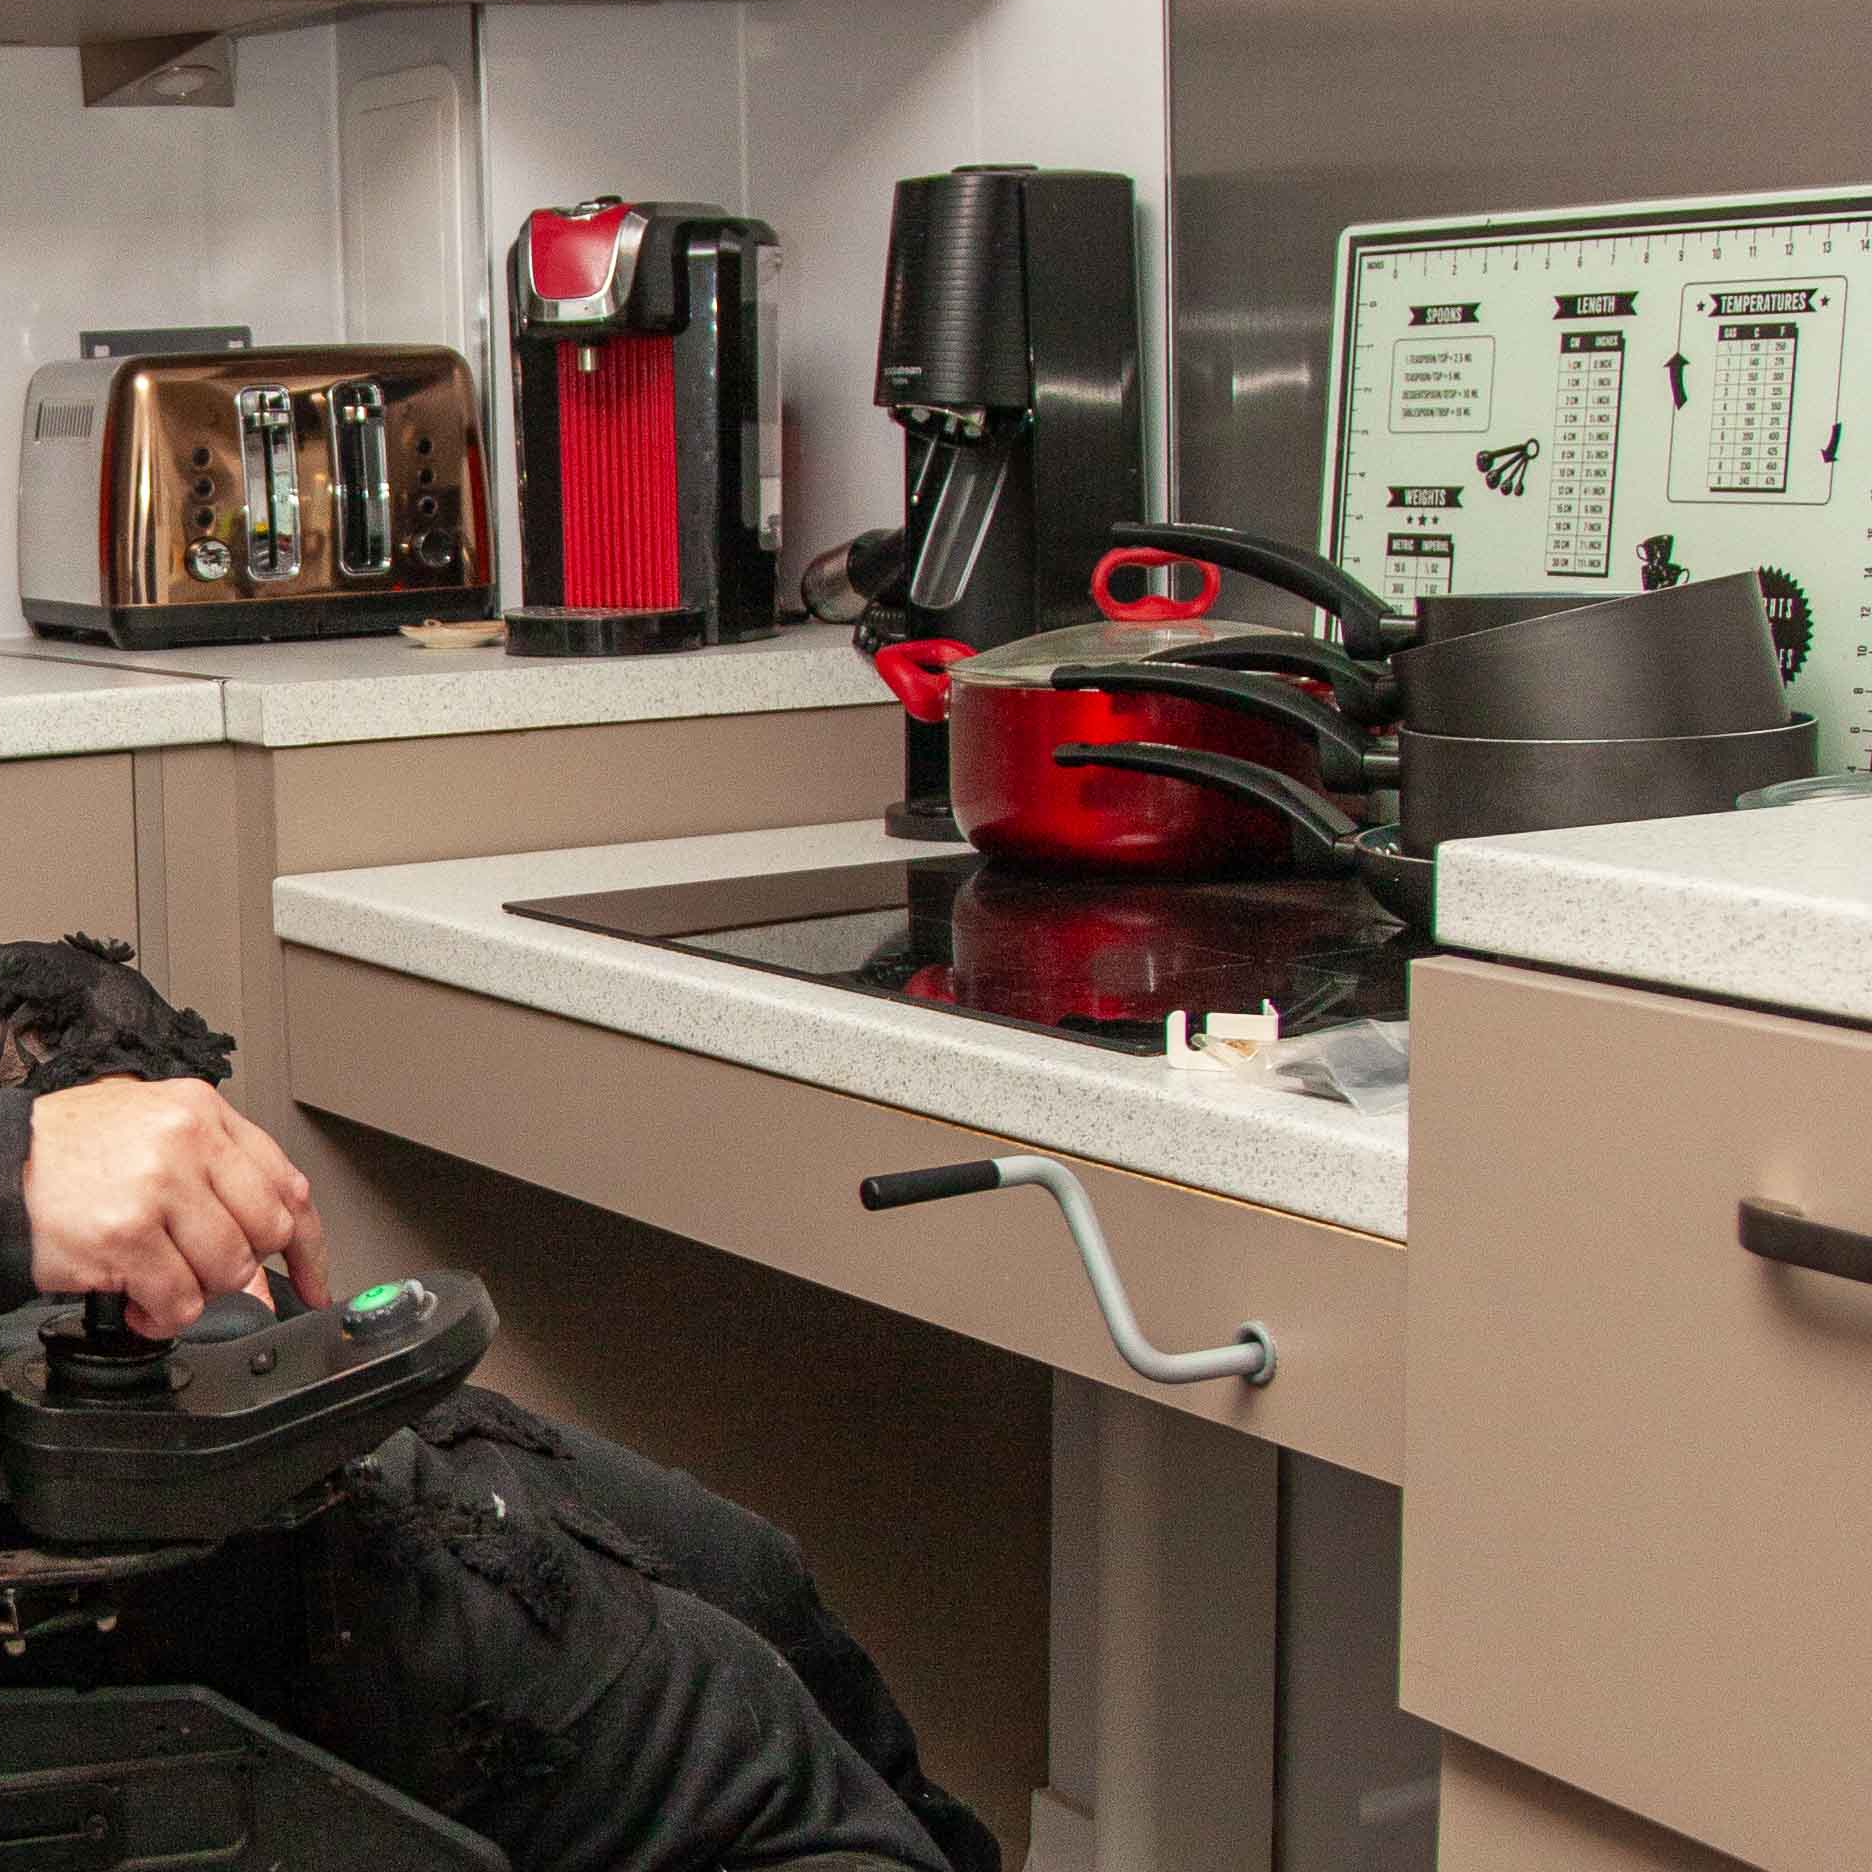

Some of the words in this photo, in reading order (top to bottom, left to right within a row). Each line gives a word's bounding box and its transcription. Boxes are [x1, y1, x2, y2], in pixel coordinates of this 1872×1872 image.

[1748, 245, 1757, 257] 11
[1785, 242, 1794, 256] 12
[1822, 240, 1831, 254] 13
[1576, 295, 1616, 314] LENGTH
[1720, 292, 1807, 314] TEMPERATURES
[1425, 306, 1463, 323] SPOONS
[1404, 488, 1447, 506] WEIGHTS
[1860, 605, 1871, 618] 12
[1856, 644, 1868, 657] 10
